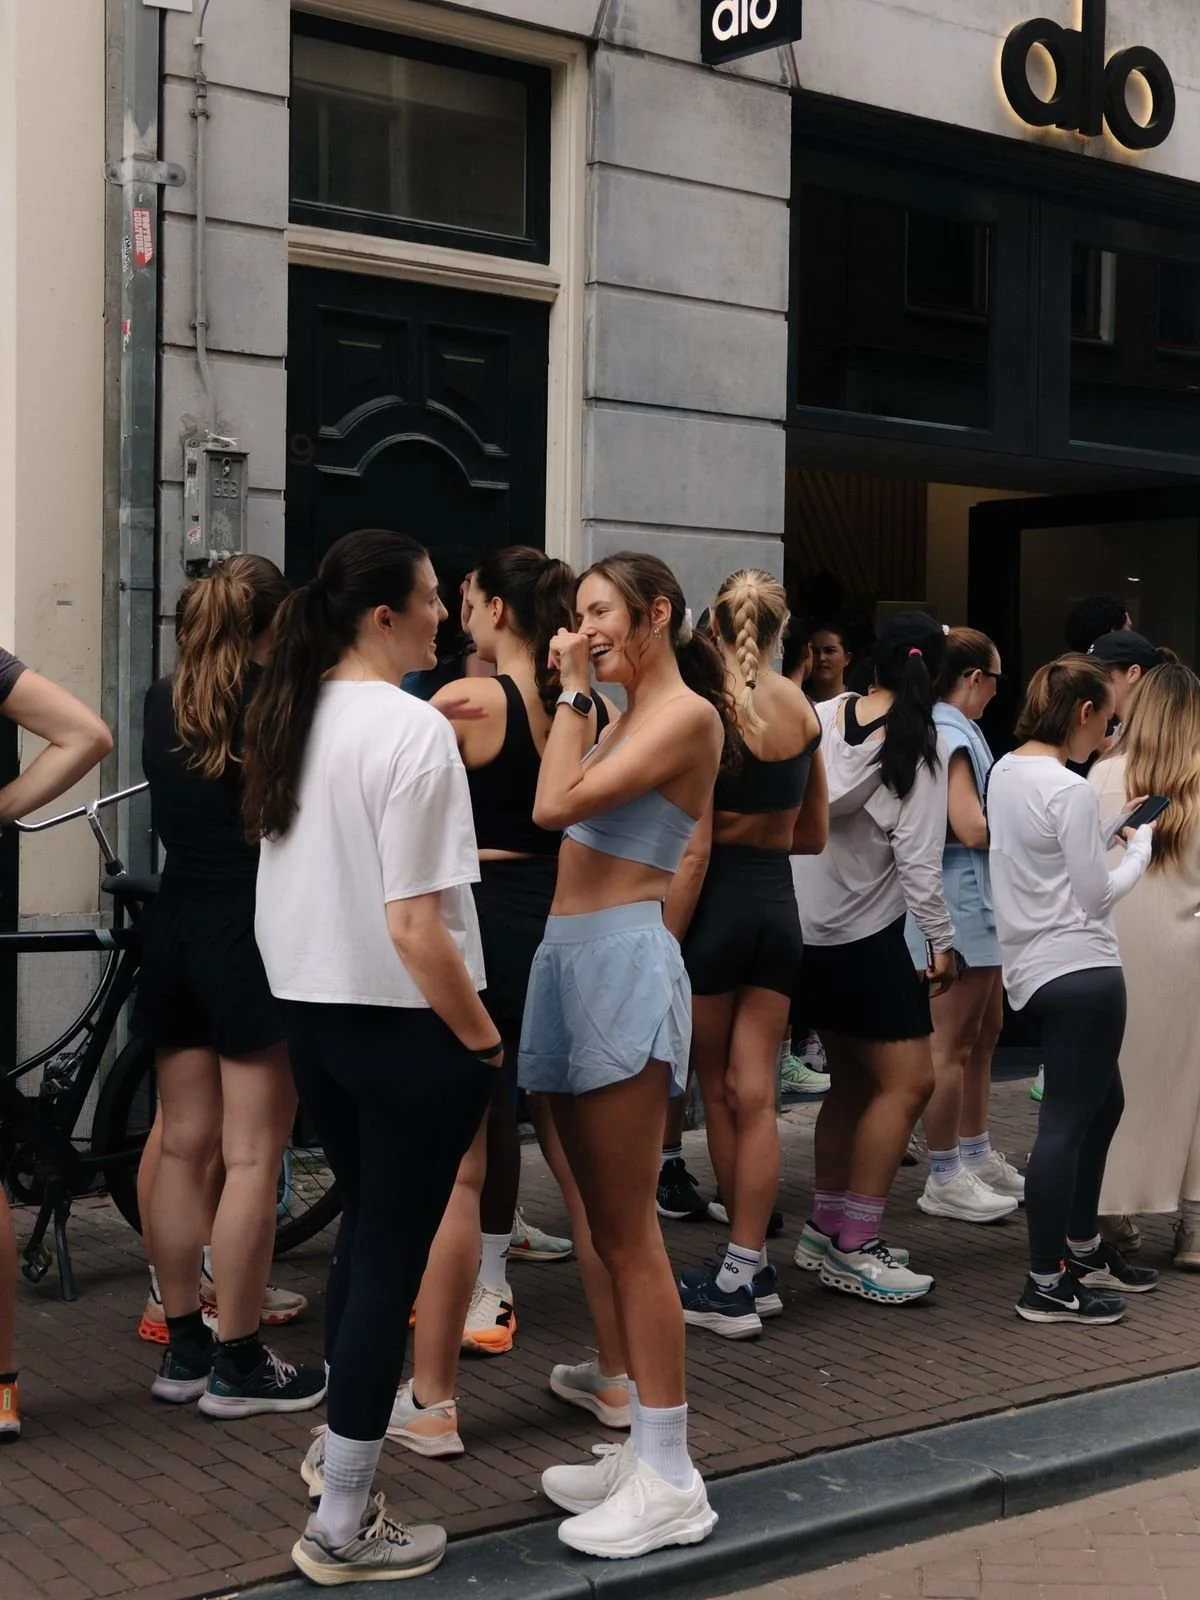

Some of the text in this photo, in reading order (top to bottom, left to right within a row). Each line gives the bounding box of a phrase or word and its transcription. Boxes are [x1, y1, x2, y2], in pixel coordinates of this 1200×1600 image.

[712, 0, 777, 41] alo
[1001, 0, 1176, 150] alo
[724, 1262, 739, 1274] alo
[660, 1434, 682, 1447] alo
